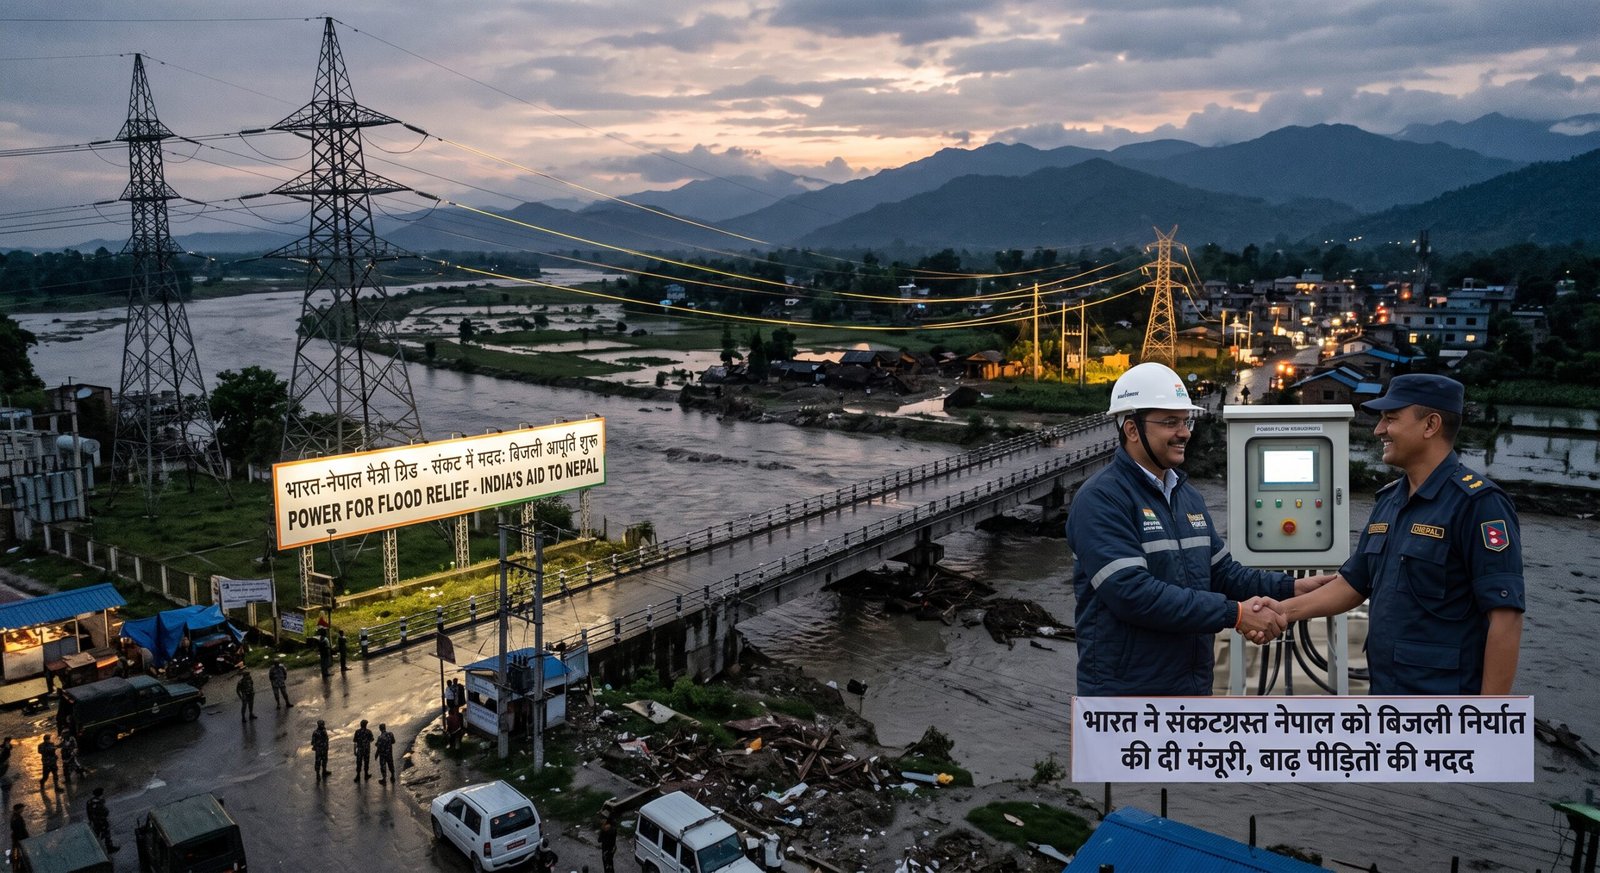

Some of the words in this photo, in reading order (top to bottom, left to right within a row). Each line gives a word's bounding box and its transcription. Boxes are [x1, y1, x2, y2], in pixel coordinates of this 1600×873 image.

[285, 469, 362, 499] भारत-नेपाल
[366, 462, 390, 487] मैत्री
[394, 458, 418, 482] ग्रिड
[431, 453, 462, 475] संकट
[465, 448, 474, 469] में
[477, 449, 506, 467] मदद:
[508, 437, 543, 463] बिजली
[546, 431, 577, 458] आपूर्ति
[579, 433, 598, 455] शुरू
[288, 503, 342, 531] POWER
[345, 497, 375, 520] FOR
[378, 488, 423, 514] FLOOD
[426, 479, 470, 505] RELIEF
[526, 466, 545, 486] AID
[547, 463, 563, 482] TO
[565, 457, 599, 479] NEPAL
[1083, 710, 1138, 734] भारत
[1143, 703, 1161, 734] ने
[1165, 704, 1269, 735] संकटग्रस्त
[1274, 703, 1335, 735] नेपाल
[1340, 703, 1373, 735] को
[1377, 703, 1453, 735] बिजली
[1458, 703, 1527, 735] निर्यात
[1121, 740, 1151, 771] की
[1157, 740, 1182, 773] दी
[1187, 740, 1253, 779] मंजूरी,
[1259, 749, 1301, 778] बाढ़
[1307, 740, 1382, 779] पीड़ितों
[1386, 740, 1418, 772] की
[1424, 749, 1475, 775] मदद
